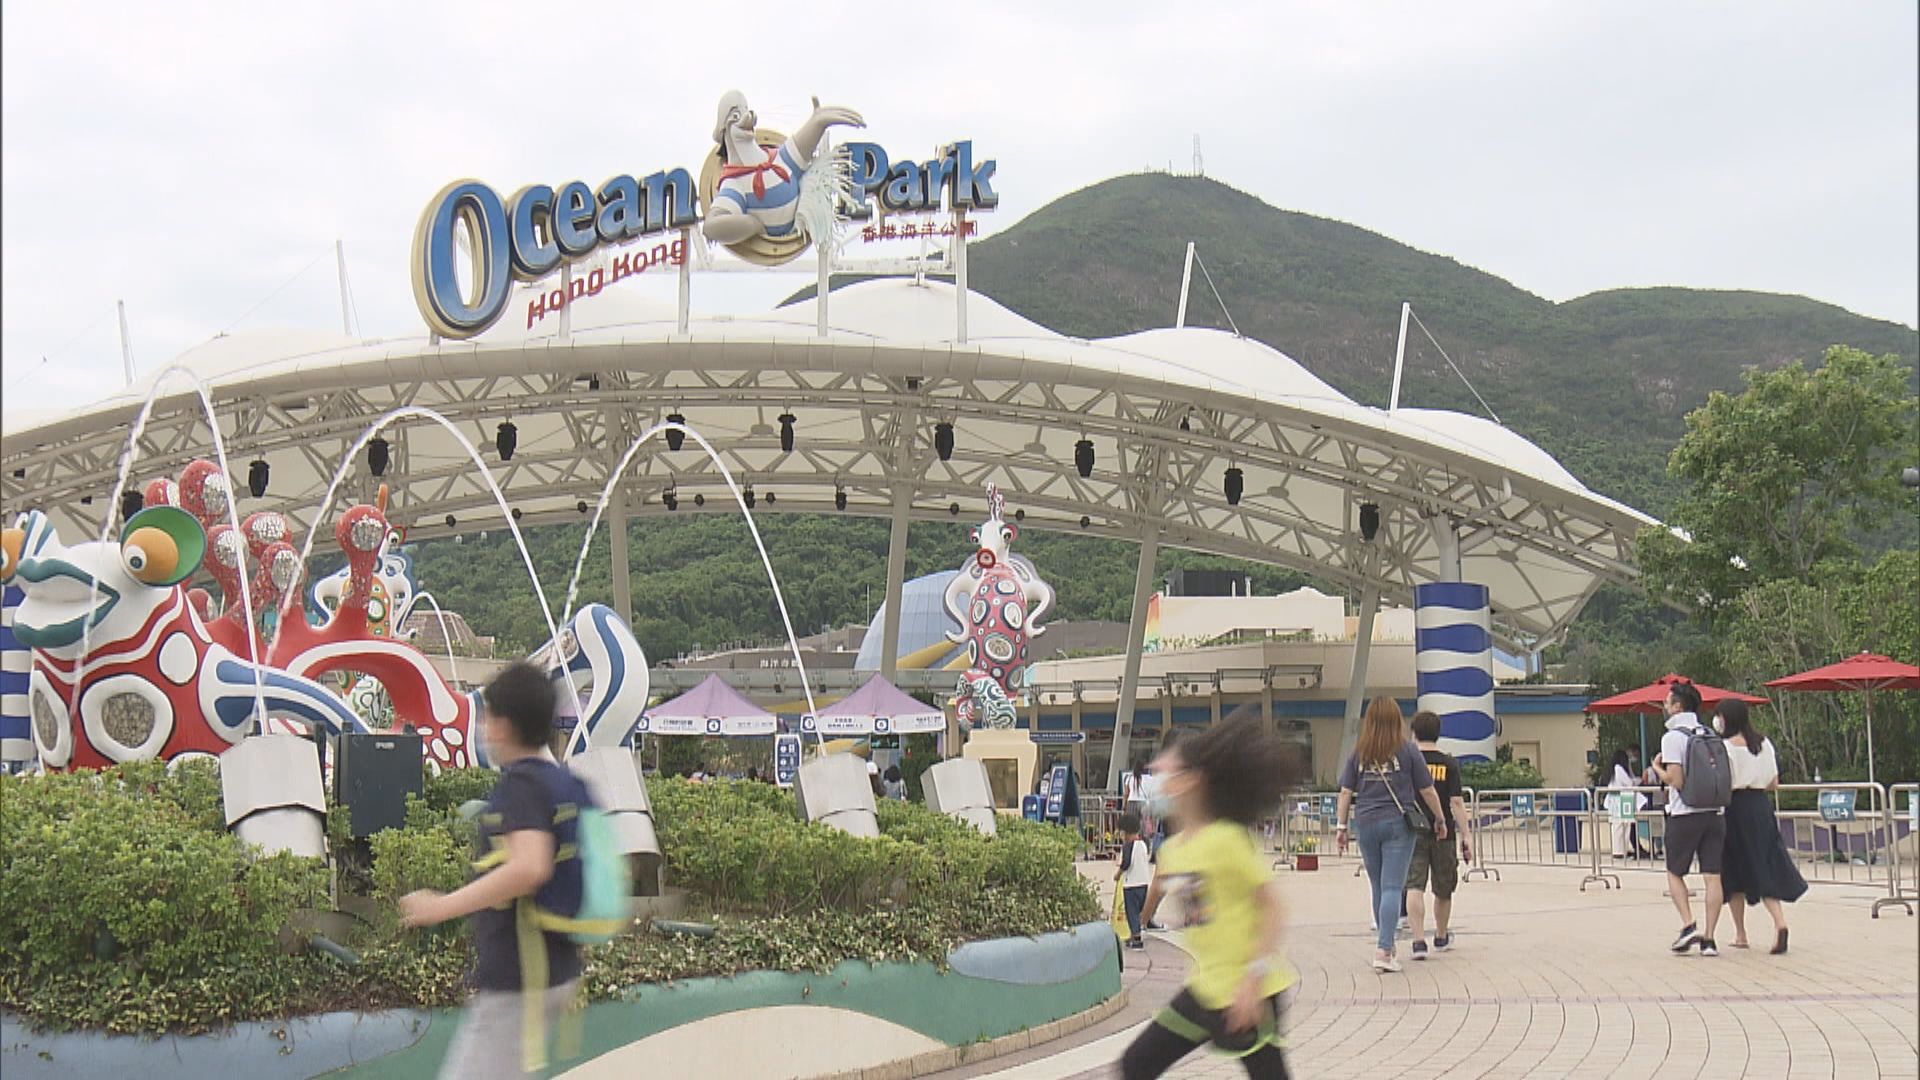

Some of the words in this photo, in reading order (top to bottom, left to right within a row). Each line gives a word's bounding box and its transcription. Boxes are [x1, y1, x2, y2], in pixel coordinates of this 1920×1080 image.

[410, 166, 697, 340] Ocean
[836, 138, 998, 220] Park
[527, 267, 604, 329] Hong
[612, 238, 687, 282] Kong
